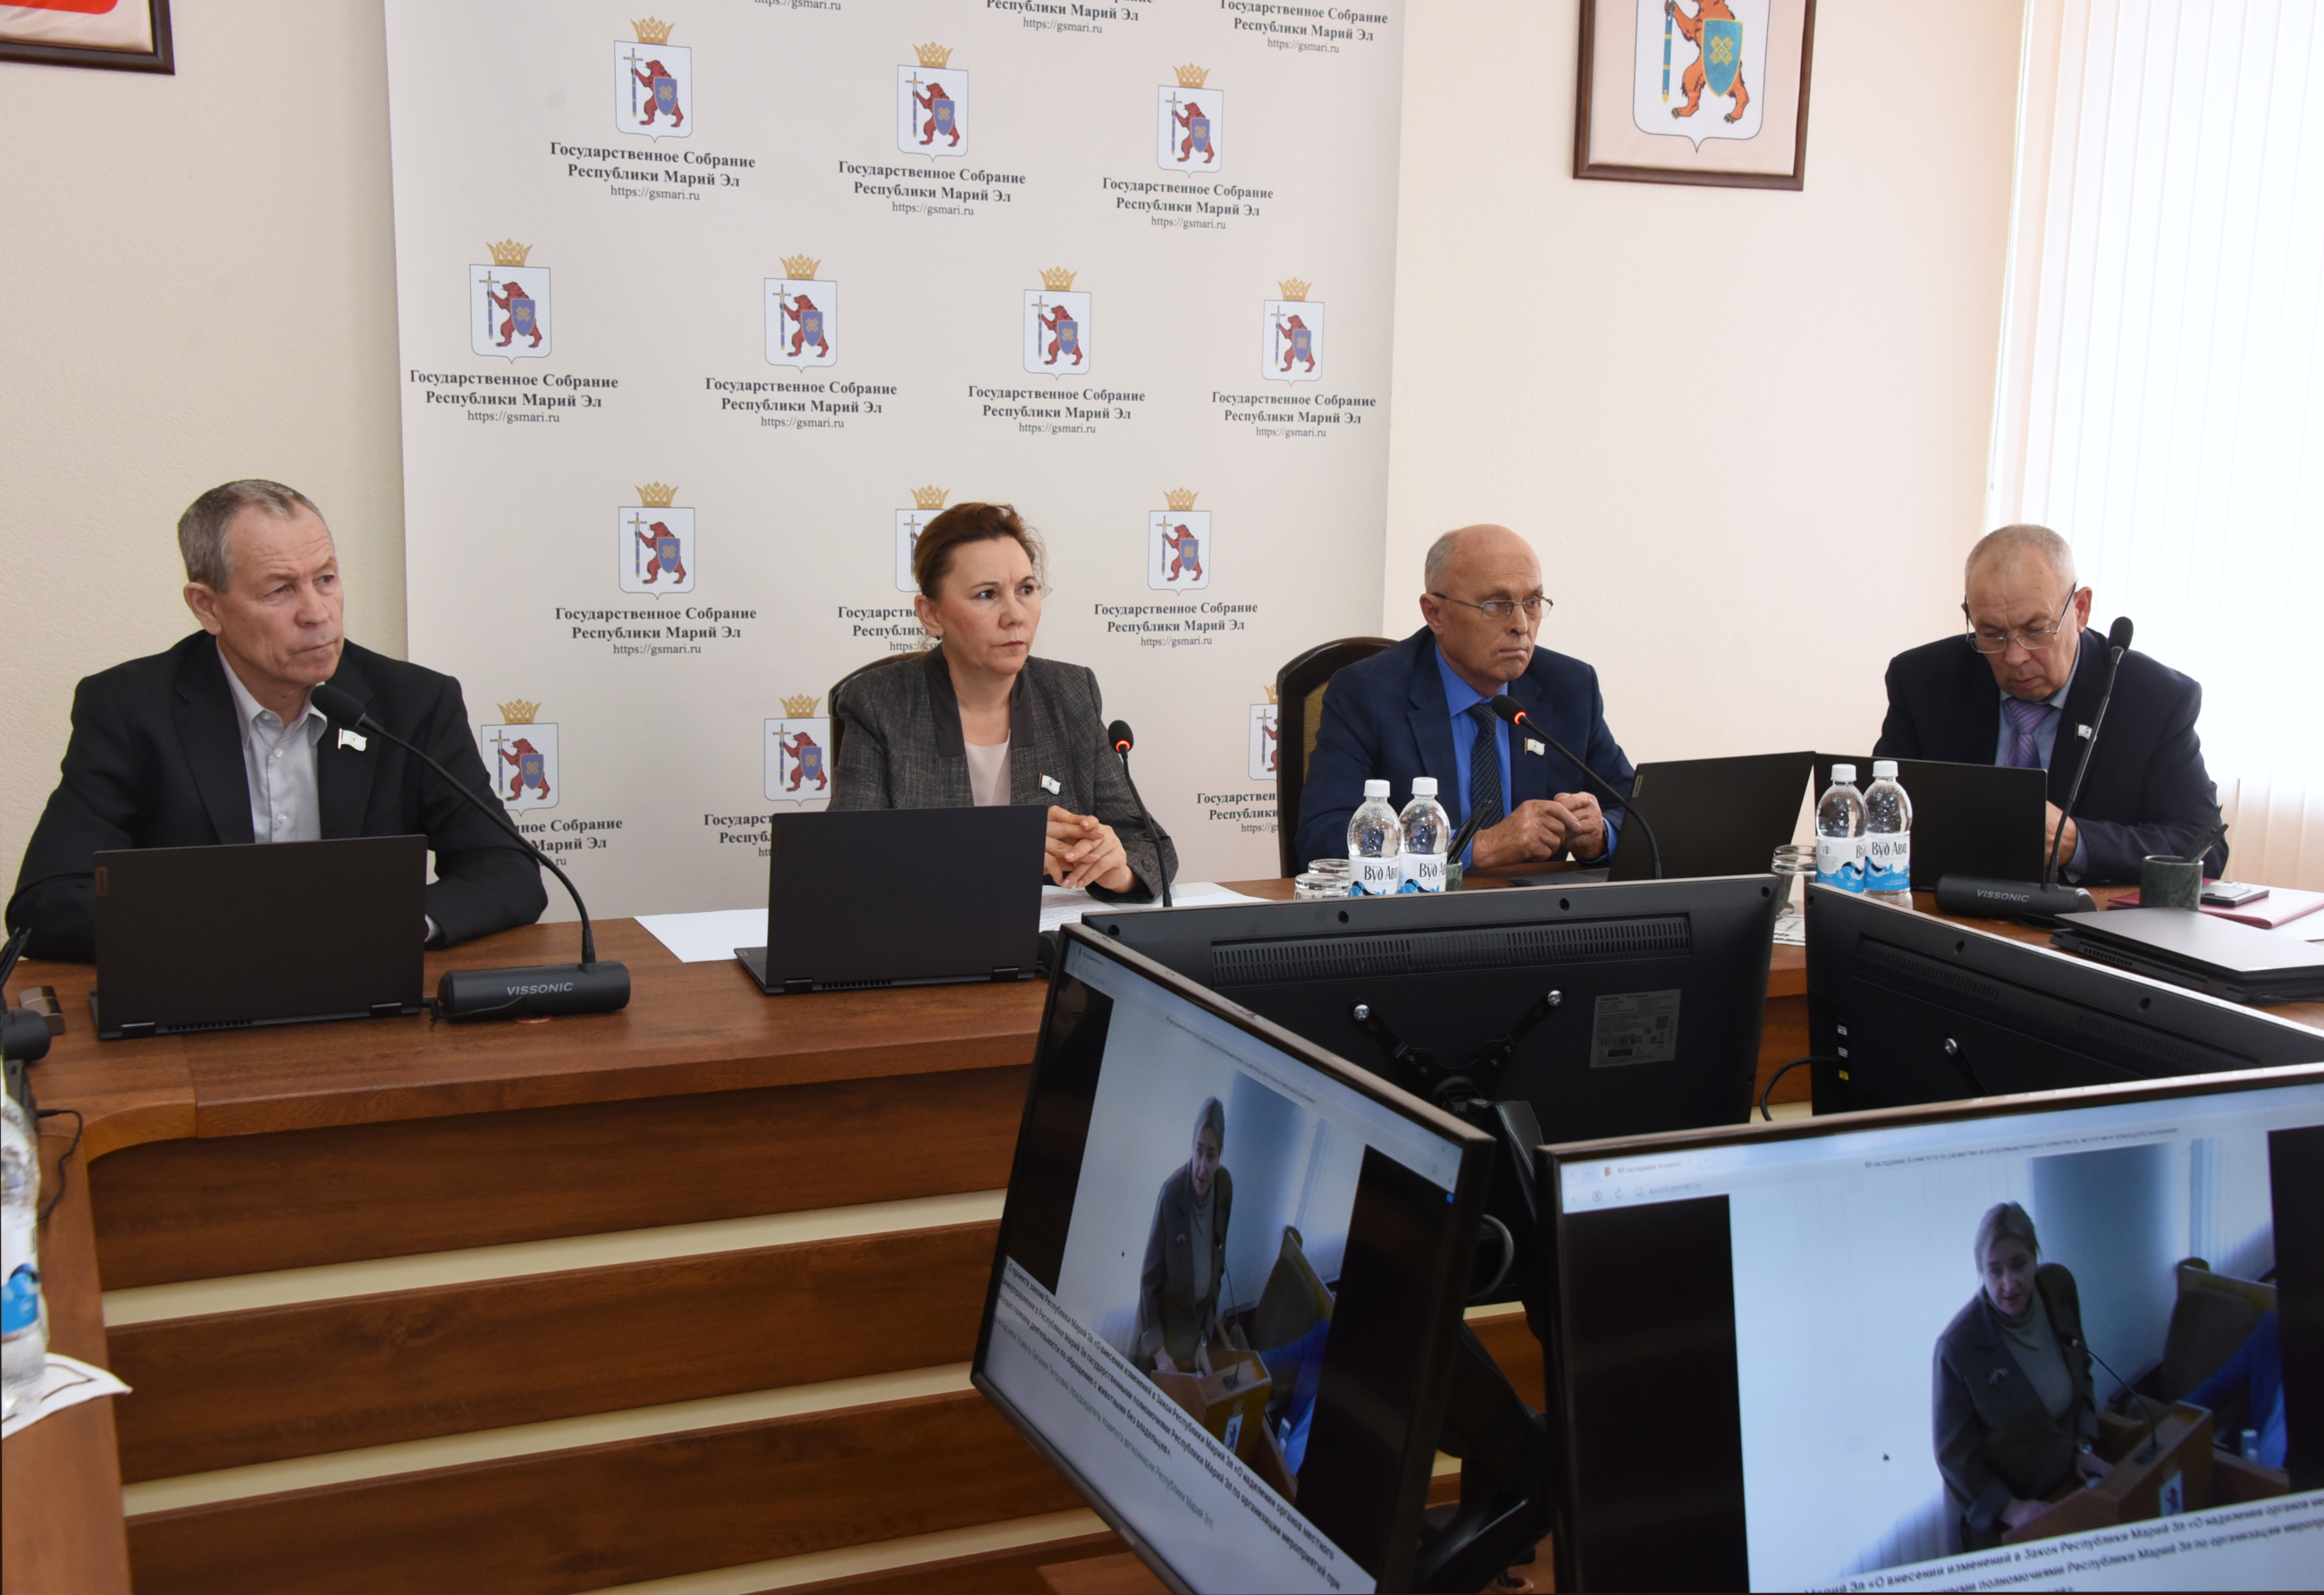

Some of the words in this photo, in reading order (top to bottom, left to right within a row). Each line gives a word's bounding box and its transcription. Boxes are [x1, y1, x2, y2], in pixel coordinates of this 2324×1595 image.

[1070, 4, 1117, 21] Марий
[1121, 8, 1139, 21] Эл
[1220, 0, 1325, 18] Государственное
[1327, 7, 1388, 24] Собрание
[1023, 17, 1103, 33] https://gsmari.ru
[1234, 17, 1307, 35] Республики
[1311, 25, 1353, 41] Марий
[1357, 30, 1374, 41] Эл
[1267, 38, 1340, 54] https://gsmari.ru
[550, 141, 679, 164] Государственное
[683, 150, 756, 170] Собрание
[568, 163, 659, 182] Республики
[663, 170, 716, 188] Марий
[720, 173, 740, 188] Эл
[838, 161, 956, 181] Государственное
[959, 169, 1026, 186] Собрание
[610, 185, 700, 201] https://gsmari.ru
[854, 181, 937, 199] Республики
[940, 187, 989, 204] Марий
[993, 190, 1011, 203] Эл
[1102, 177, 1210, 196] Государственное
[1214, 184, 1274, 200] Собрание
[891, 201, 974, 216] https://gsmari.ru
[1116, 197, 1192, 214] Республики
[1197, 202, 1240, 218] Марий
[1244, 205, 1260, 217] Эл
[1150, 216, 1226, 231] https://gsmari.ru
[409, 369, 539, 388] Государственное
[543, 373, 619, 391] Собрание
[705, 377, 826, 395] Государственное
[829, 382, 897, 398] Собрание
[425, 391, 518, 409] Республики
[522, 393, 577, 410] Марий
[581, 395, 602, 408] Эл
[968, 385, 1080, 402] Государственное
[1083, 389, 1146, 404] Собрание
[1212, 392, 1311, 407] Государственное
[1315, 394, 1377, 409] Собрание
[721, 398, 806, 414] Республики
[810, 401, 860, 417] Марий
[863, 401, 882, 414] Эл
[983, 405, 1061, 420] Республики
[1065, 407, 1110, 422] Марий
[1115, 408, 1132, 420] Эл
[467, 410, 560, 425] https://gsmari.ru
[761, 417, 845, 430] https://gsmari.ru
[1224, 409, 1294, 423] Республики
[1298, 412, 1341, 426] Марий
[1344, 413, 1361, 425] Эл
[1019, 423, 1096, 435] https://gsmari.ru
[1256, 426, 1326, 439] https://gsmari.ru
[555, 607, 682, 623] Государственное
[686, 607, 757, 623] Собрание
[838, 606, 919, 621] Государстве
[1094, 603, 1198, 618] Государственное
[1200, 603, 1258, 616] Собрание
[571, 627, 661, 643] Республики
[666, 626, 717, 642] Марий
[722, 625, 741, 638] Эл
[852, 624, 929, 639] Республик
[1107, 620, 1181, 636] Республики
[1184, 620, 1225, 635] Марий
[1228, 619, 1245, 631] Эл
[613, 645, 702, 657] https://gsmari.ru
[1141, 636, 1213, 649] https://gsmari.ru
[1197, 792, 1276, 806] Государствен
[703, 814, 772, 828] Государст
[1208, 808, 1278, 822] Республики
[550, 819, 623, 834] Собрание
[531, 838, 583, 854] Марий
[587, 837, 607, 848] Эл
[719, 831, 771, 846] Респуб
[1977, 890, 2029, 903] VISSONIC
[506, 982, 573, 996] VISSONIC
[1044, 1294, 1071, 1324] Республики
[1071, 1315, 1088, 1338] Марий
[1124, 1365, 1153, 1396] изменений
[1156, 1395, 1173, 1415] Закон
[1172, 1405, 1206, 1444] Республики
[1205, 1437, 1226, 1463] Марий
[1242, 1473, 1276, 1510] наделении
[1276, 1503, 1302, 1532] органов
[1302, 1525, 1335, 1561] местного
[1133, 1396, 1171, 1436] полномочиями
[1170, 1428, 1205, 1467] Республики
[1204, 1458, 1225, 1484] Марий
[1241, 1495, 1281, 1537] организации
[1281, 1530, 1327, 1580] мероприятий
[1326, 1571, 1341, 1591] при
[1887, 1565, 1945, 1586] внесении
[1947, 1552, 2011, 1580] изменений
[2024, 1543, 2059, 1560] Закон
[2059, 1531, 2129, 1553] Республики
[2131, 1523, 2169, 1540] Марий
[1978, 1566, 2066, 1591] полномочиями
[2067, 1551, 2136, 1574] Республики
[2138, 1542, 2177, 1560] Марий
